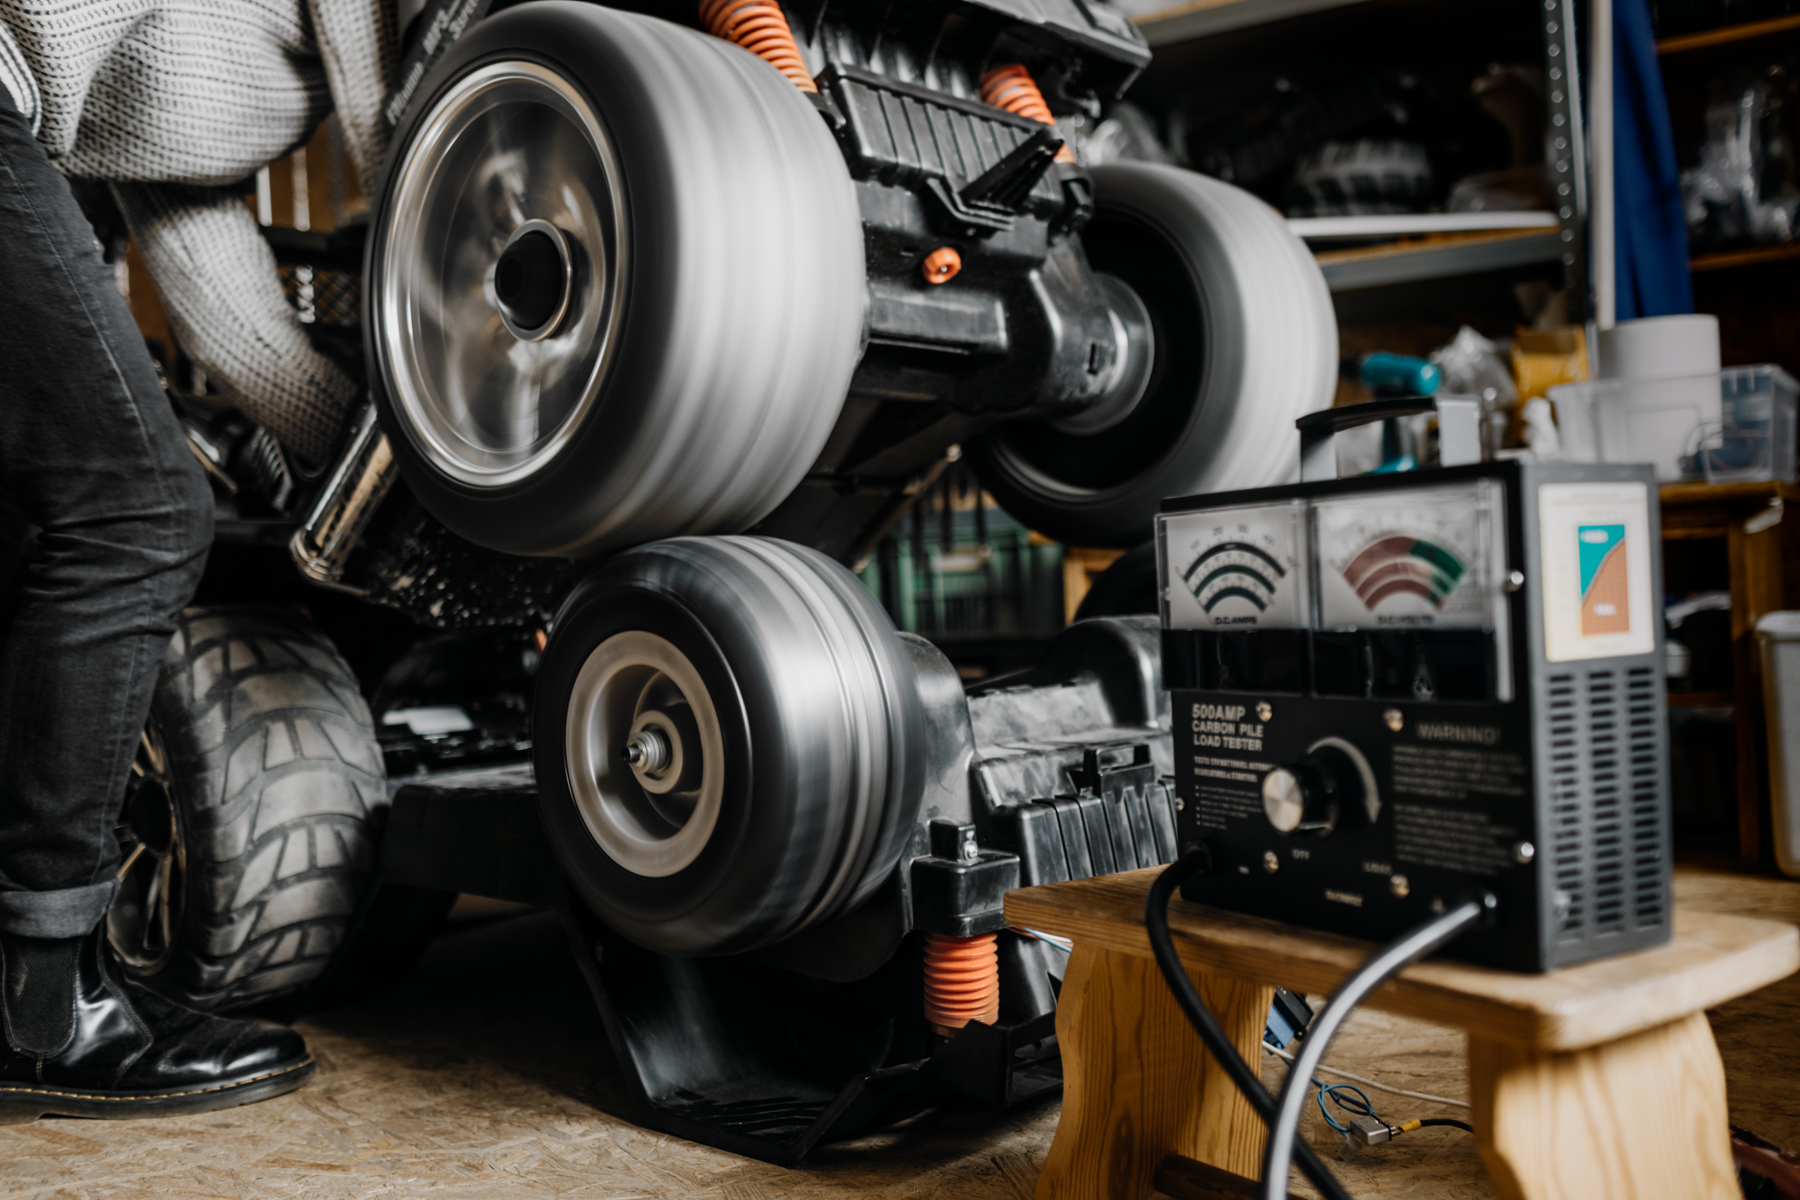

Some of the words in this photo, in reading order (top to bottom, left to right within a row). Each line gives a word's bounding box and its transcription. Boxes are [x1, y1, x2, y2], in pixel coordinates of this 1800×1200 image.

[1192, 703, 1246, 721] 500AMP
[1192, 719, 1236, 735] CARBON
[1240, 723, 1264, 738] PILE
[1193, 734, 1221, 748] LOAD
[1222, 736, 1263, 752] TESTER
